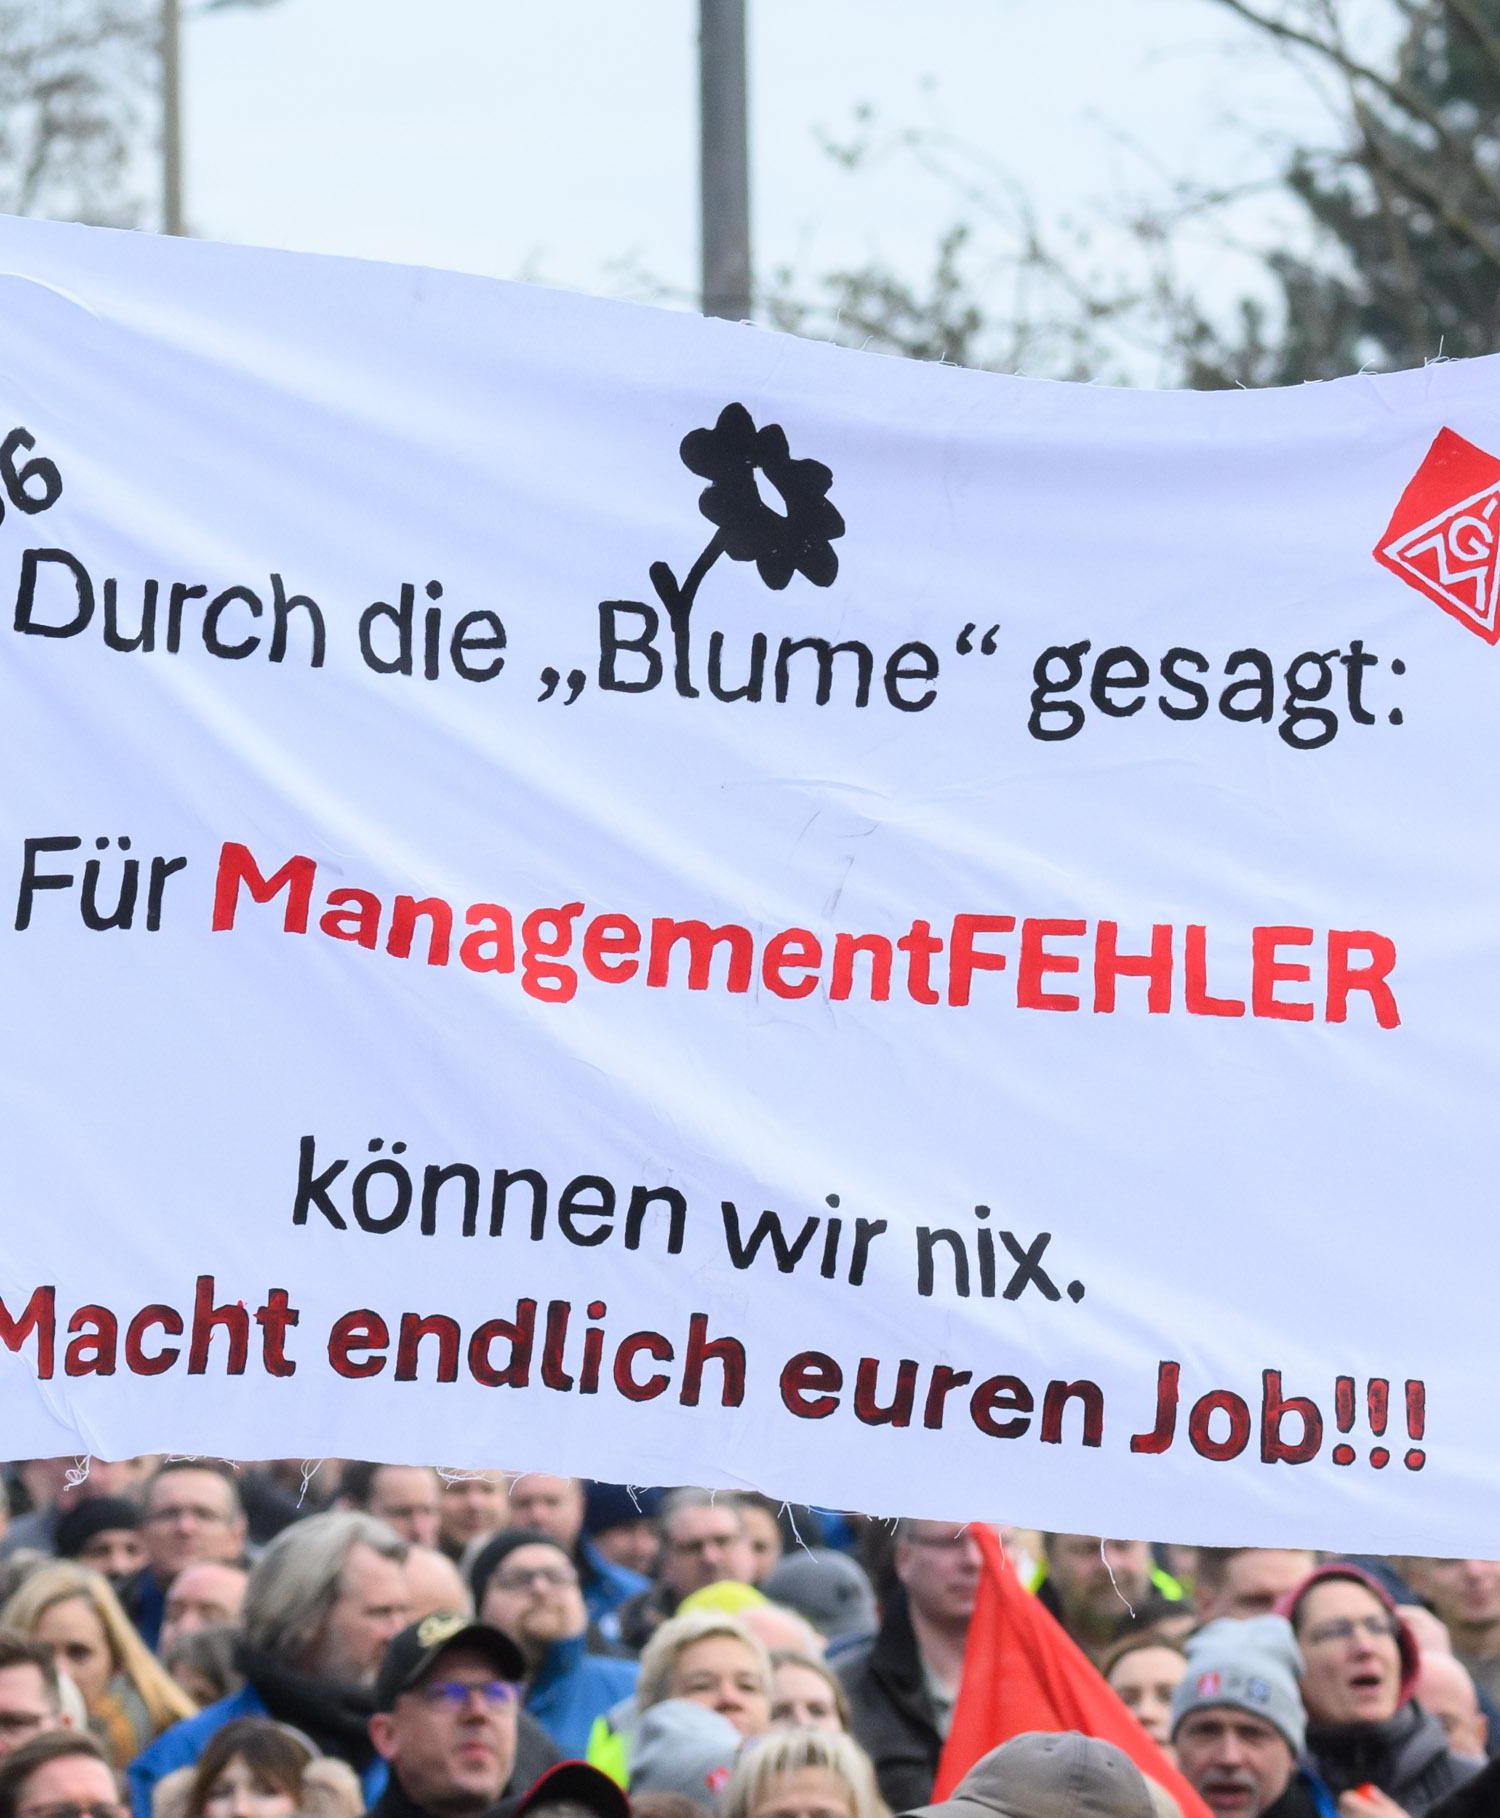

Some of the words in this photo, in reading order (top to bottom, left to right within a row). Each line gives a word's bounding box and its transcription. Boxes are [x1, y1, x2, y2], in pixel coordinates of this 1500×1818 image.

[14, 548, 325, 668] Durch
[359, 580, 506, 682] die
[1028, 640, 1405, 749] gesagt:
[15, 836, 187, 931] Für
[212, 842, 1401, 1029] ManagementFEHLER
[293, 1136, 687, 1254] können
[721, 1194, 887, 1286] wir
[917, 1206, 1085, 1303] nix.
[327, 1298, 746, 1407] endlich
[780, 1351, 1104, 1447] euren
[1130, 1361, 1425, 1471] Job!!!
